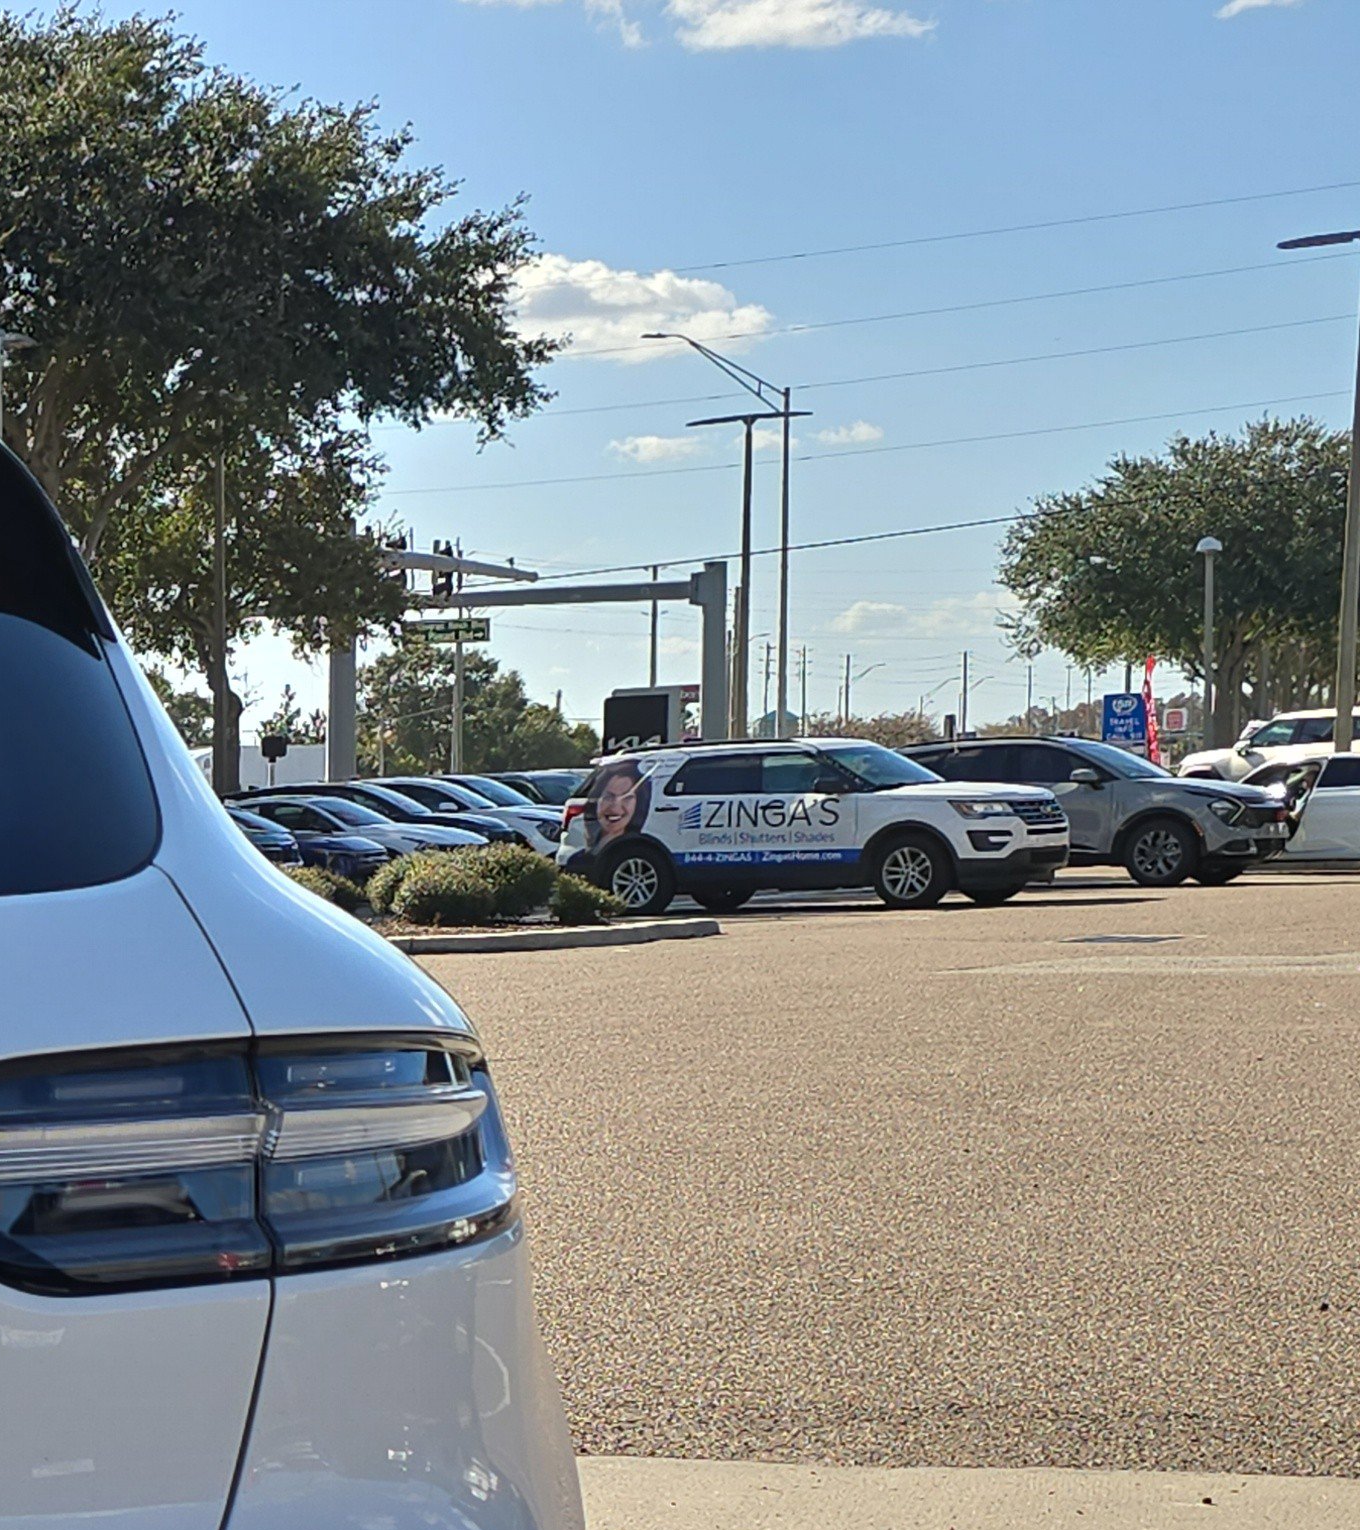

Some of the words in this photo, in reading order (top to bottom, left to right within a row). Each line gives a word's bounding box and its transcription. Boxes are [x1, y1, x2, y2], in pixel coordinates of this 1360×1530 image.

[704, 797, 841, 829] ZINGA'S
[698, 832, 733, 846] Blinds
[738, 831, 787, 845] Shutters
[793, 830, 836, 844] Shades
